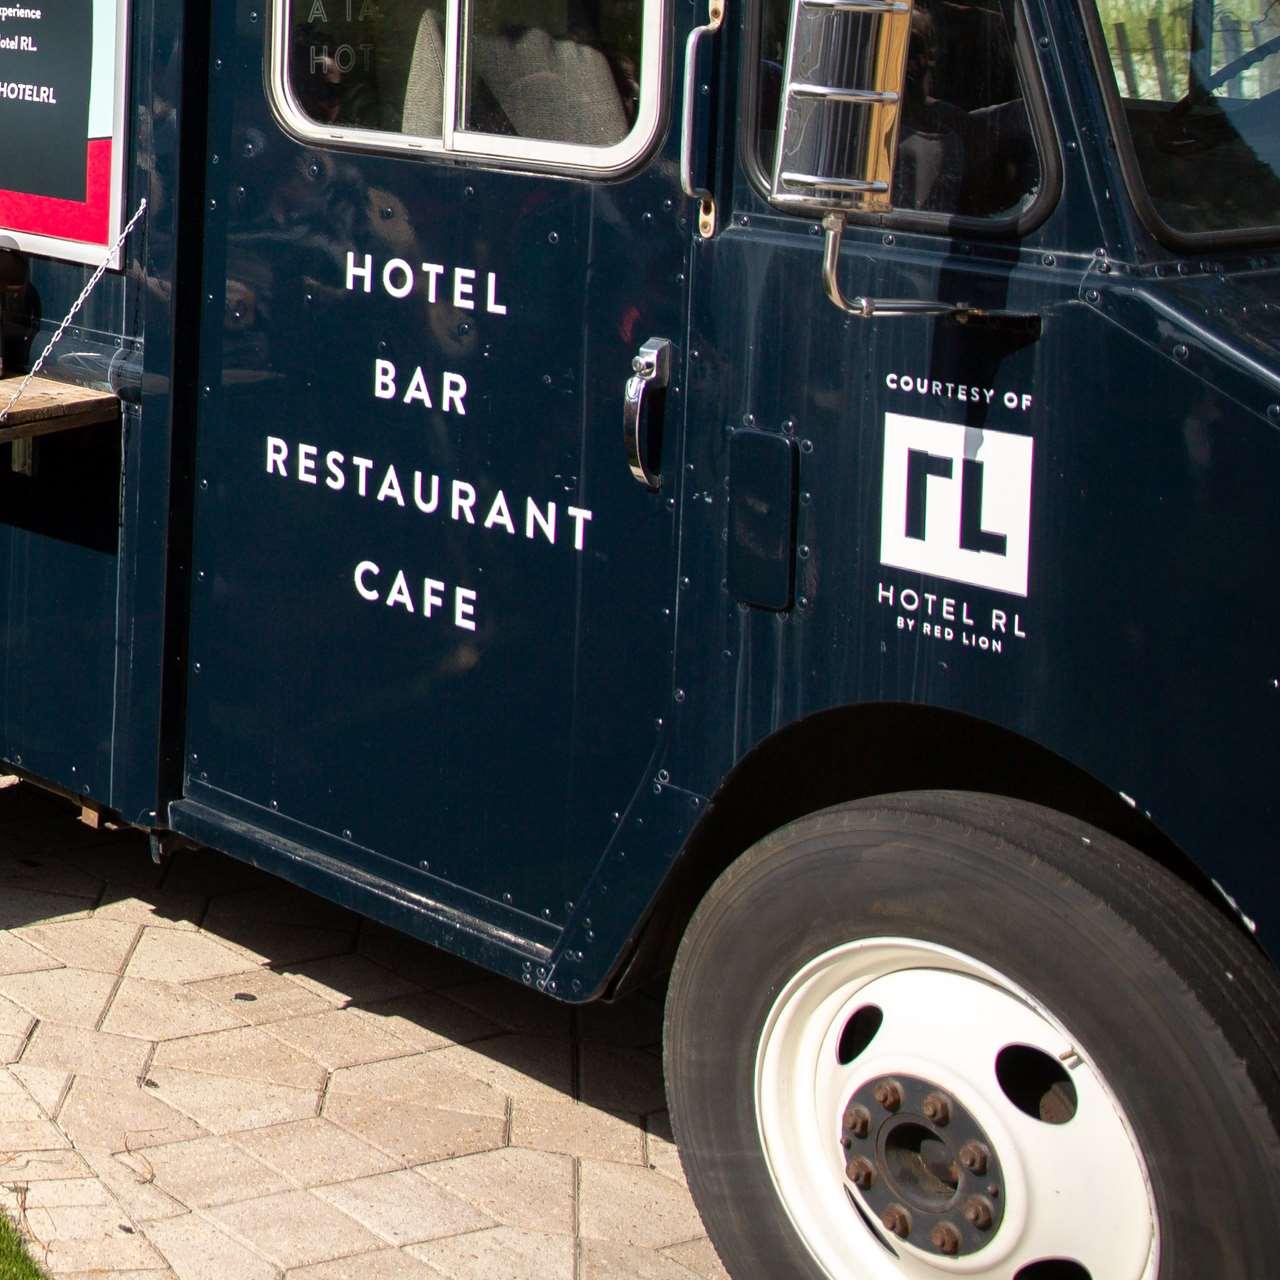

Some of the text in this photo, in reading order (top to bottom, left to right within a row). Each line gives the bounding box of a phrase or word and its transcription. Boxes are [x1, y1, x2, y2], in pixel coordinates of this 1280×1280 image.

[20, 36, 37, 51] RL.
[345, 251, 507, 316] HOTEL
[374, 358, 468, 415] BAR
[885, 373, 1032, 411] COURTESY OF
[266, 435, 592, 551] RESTAURANT
[353, 560, 477, 631] CAFE
[878, 582, 1026, 638] HOTEL RL
[897, 616, 1002, 653] BY RED LION
